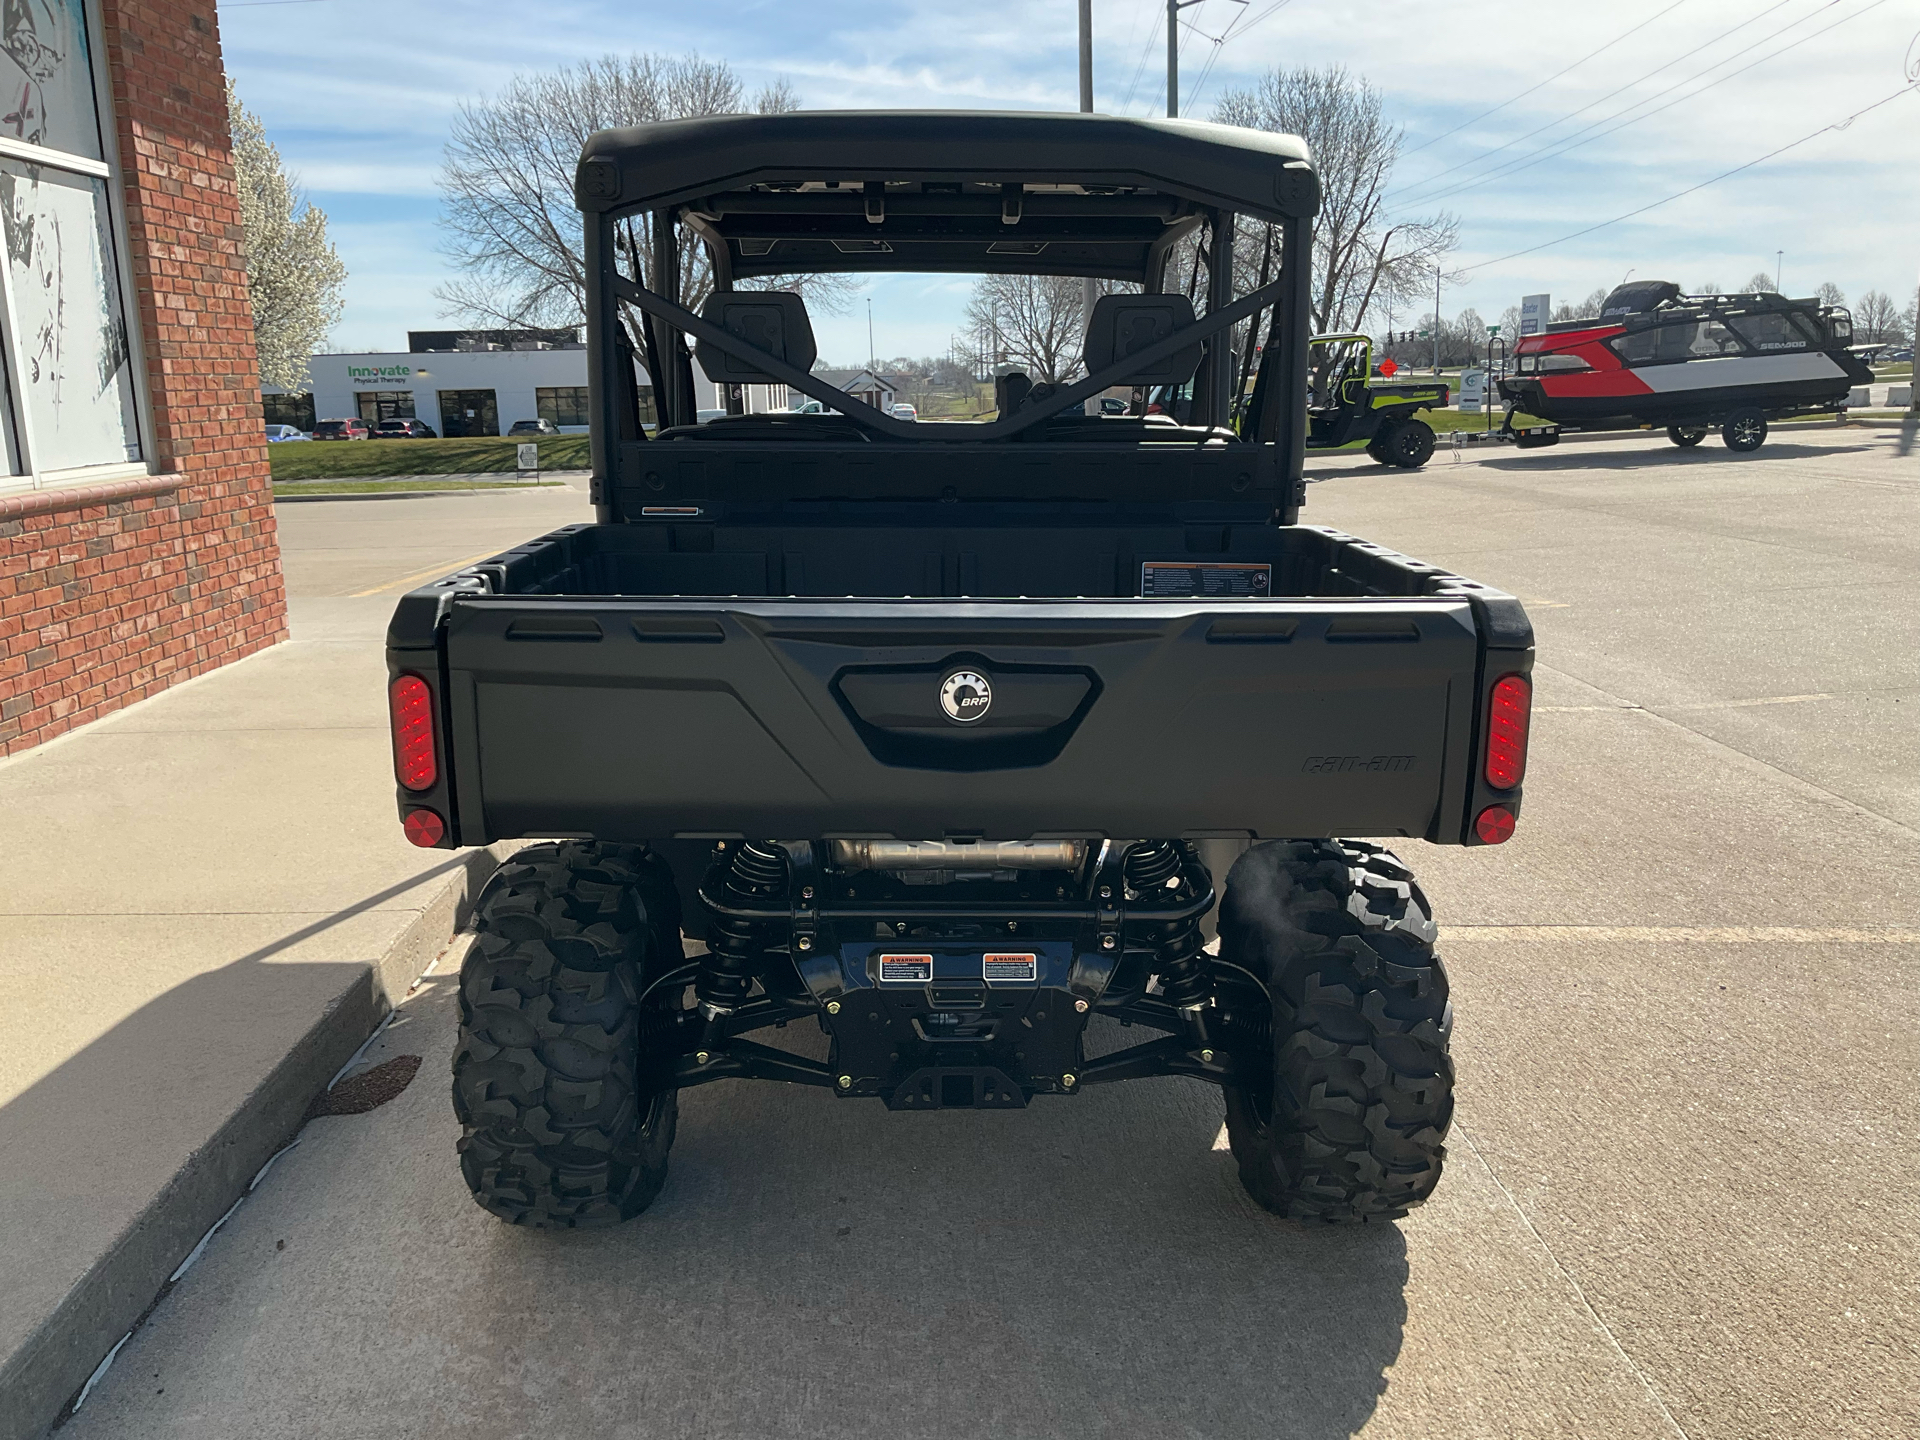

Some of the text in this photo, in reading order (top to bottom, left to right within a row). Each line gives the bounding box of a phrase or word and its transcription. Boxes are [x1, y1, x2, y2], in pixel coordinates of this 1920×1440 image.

[1522, 303, 1538, 314] Baxter
[347, 365, 410, 377] Innovate
[354, 377, 378, 385] Physical
[961, 697, 988, 706] BRP
